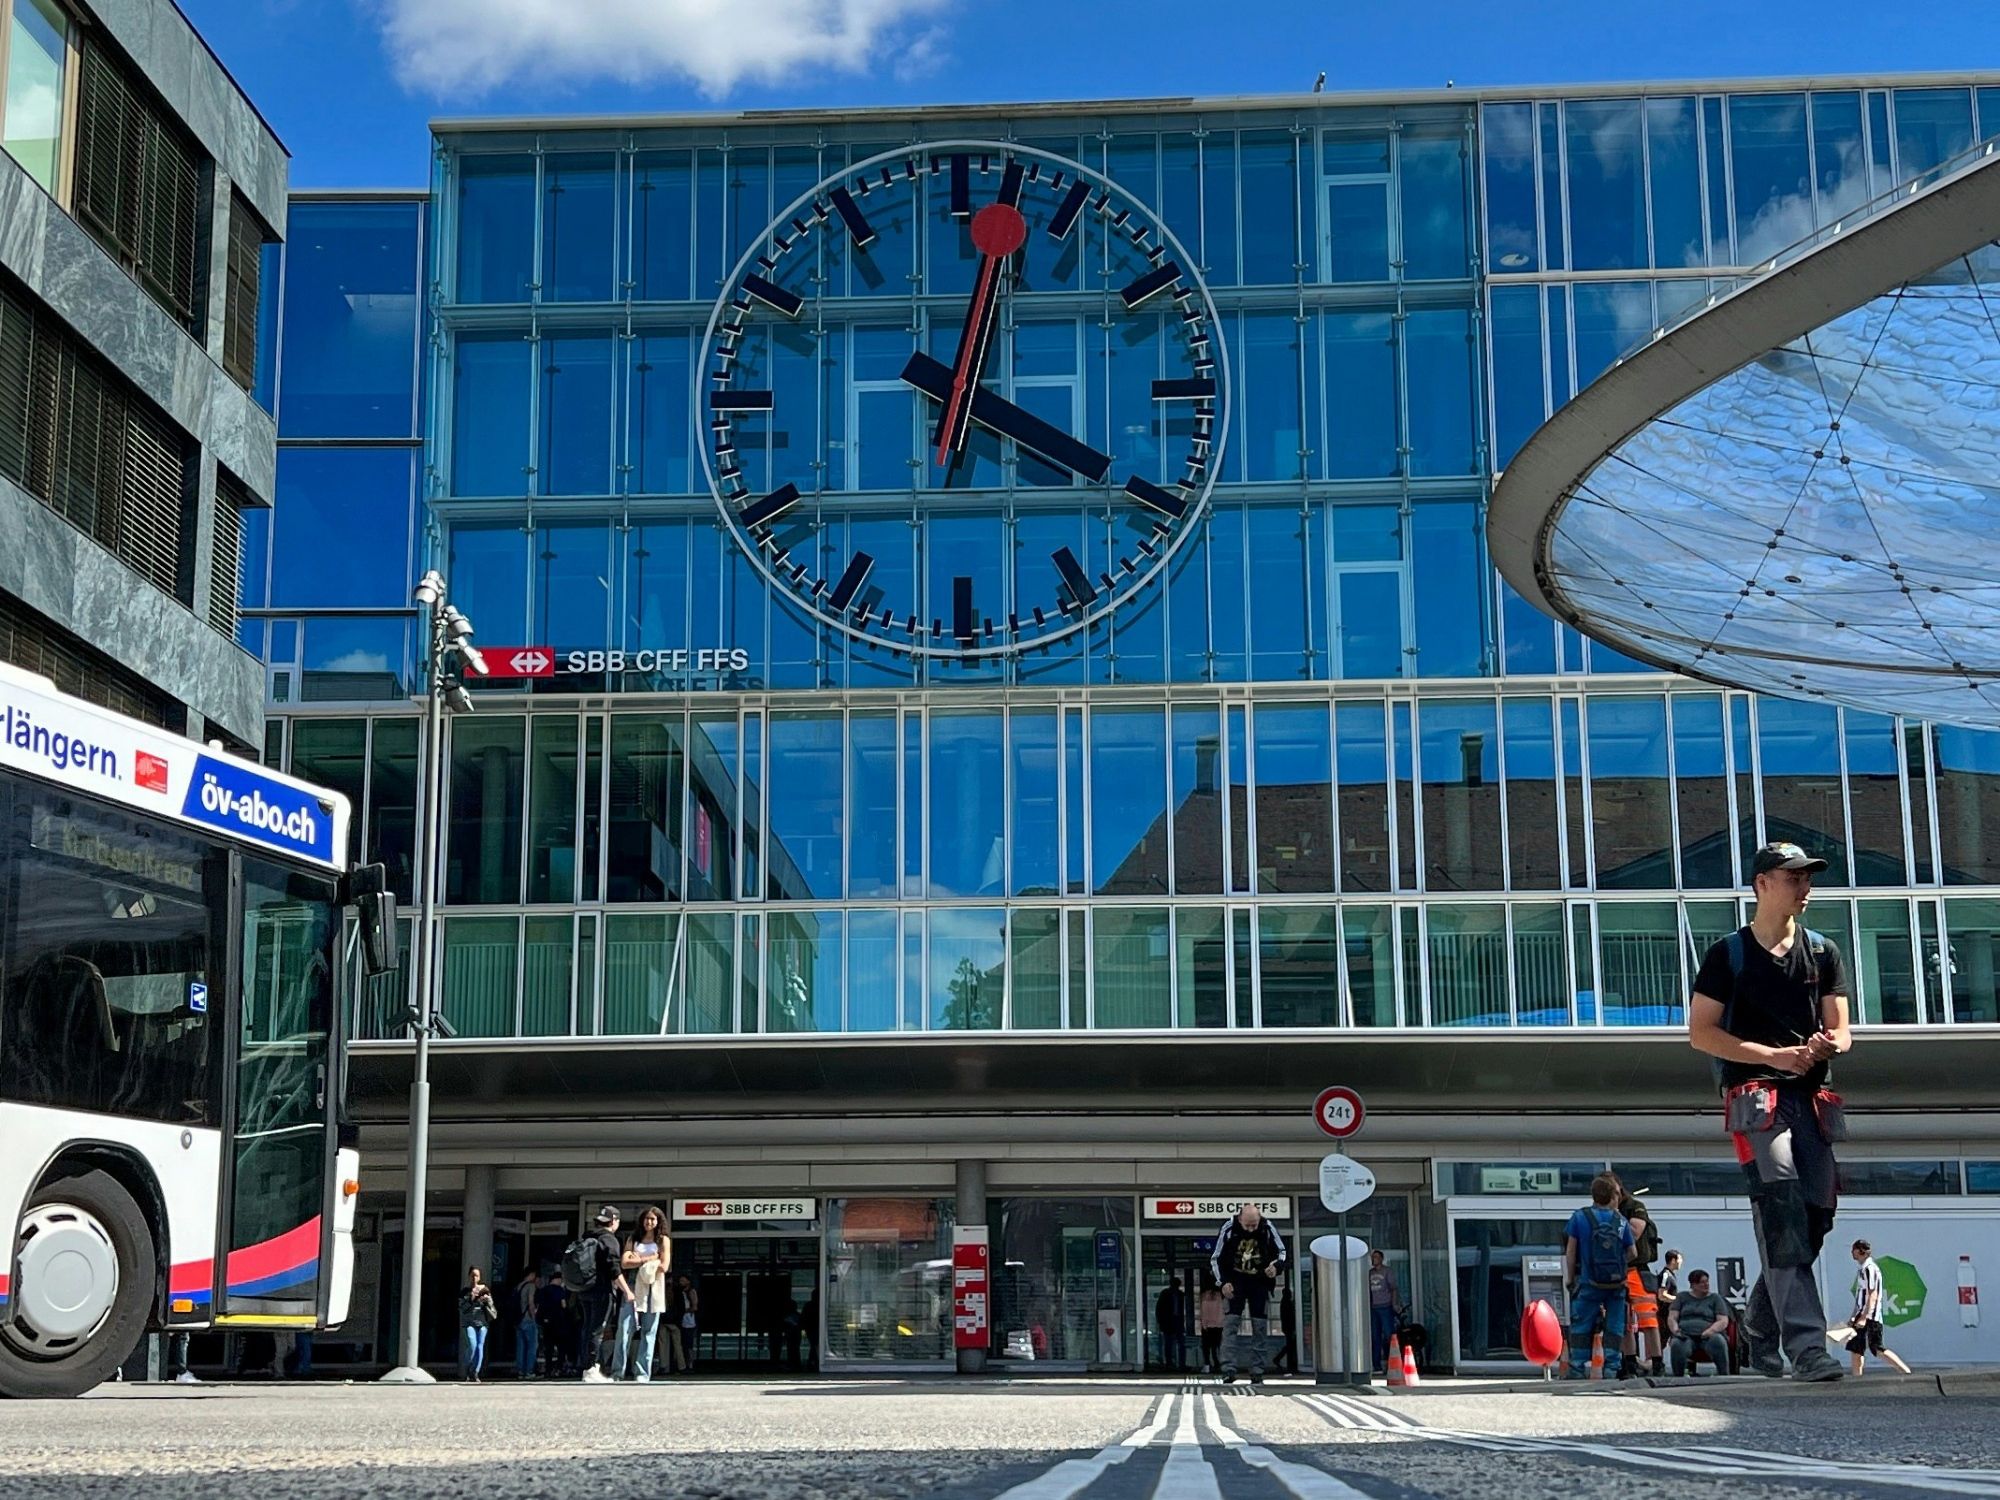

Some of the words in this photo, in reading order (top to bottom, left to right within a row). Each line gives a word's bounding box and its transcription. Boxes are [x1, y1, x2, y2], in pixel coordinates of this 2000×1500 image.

[568, 649, 626, 673] SBB
[636, 648, 688, 672] CFF
[698, 647, 749, 671] FFS
[0, 705, 122, 780] längern.
[201, 773, 315, 845] öv-abo.ch
[726, 1203, 751, 1214] SBB
[753, 1203, 777, 1214] CFF
[780, 1203, 804, 1214] FFS
[1198, 1202, 1223, 1213] SBB
